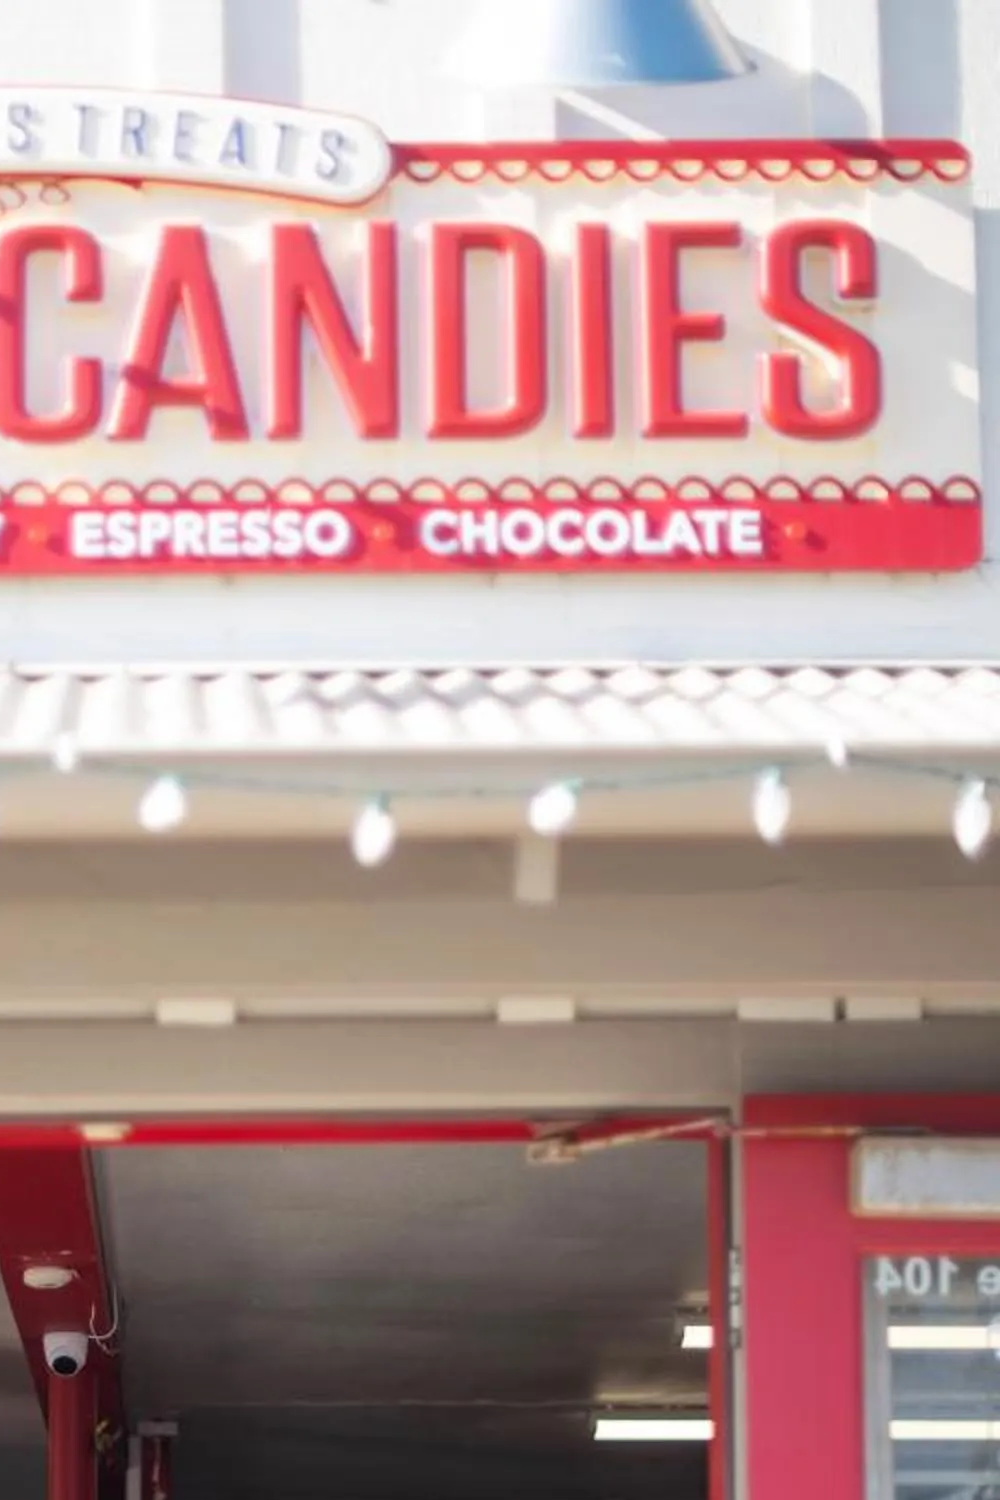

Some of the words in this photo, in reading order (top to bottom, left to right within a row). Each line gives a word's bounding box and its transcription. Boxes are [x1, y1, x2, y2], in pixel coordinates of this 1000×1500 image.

[72, 103, 358, 184] TREATS
[71, 510, 351, 559] ESPRESSO
[419, 509, 763, 556] CHOCOLATE
